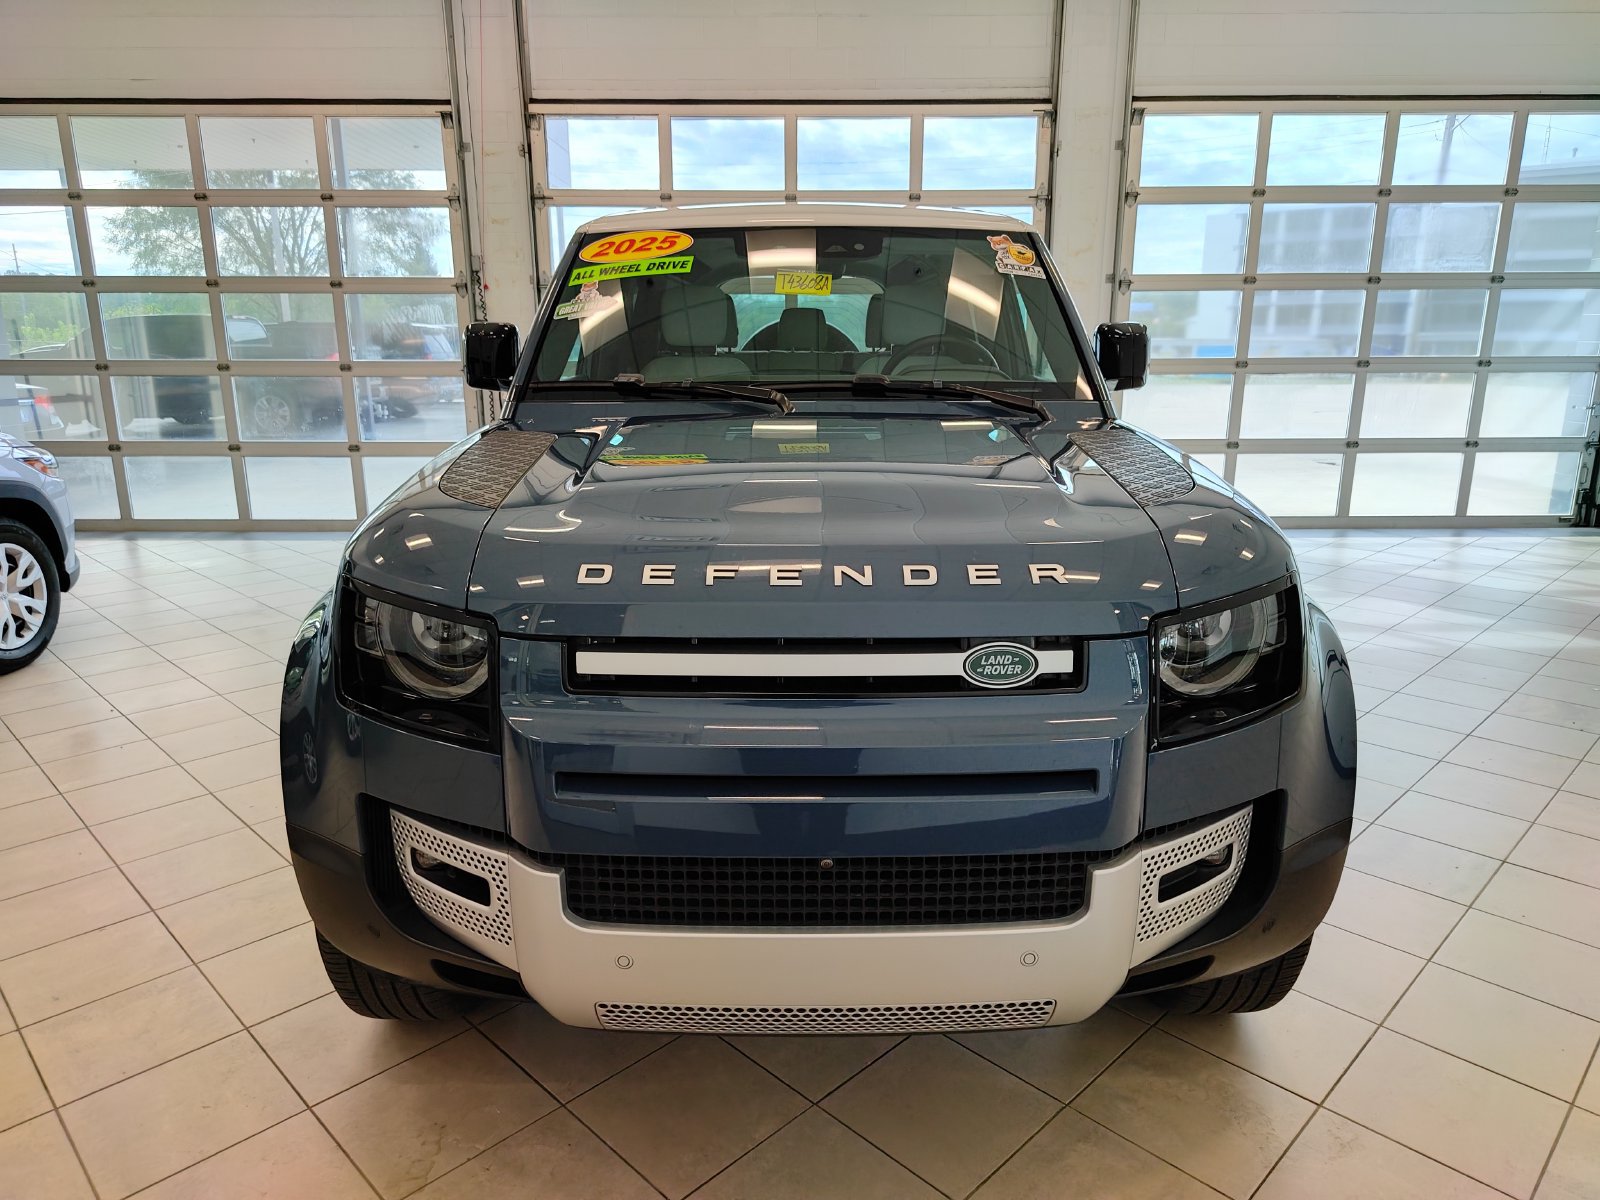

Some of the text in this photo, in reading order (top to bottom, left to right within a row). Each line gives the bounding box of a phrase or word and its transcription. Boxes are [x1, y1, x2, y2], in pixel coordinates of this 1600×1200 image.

[590, 235, 682, 259] 2025
[572, 259, 691, 281] ALL WHEEL DRIVE
[559, 303, 584, 316] GREAT
[576, 563, 1069, 587] DEFENDER
[981, 655, 1013, 665] LAND
[984, 665, 1022, 675] ROVER
